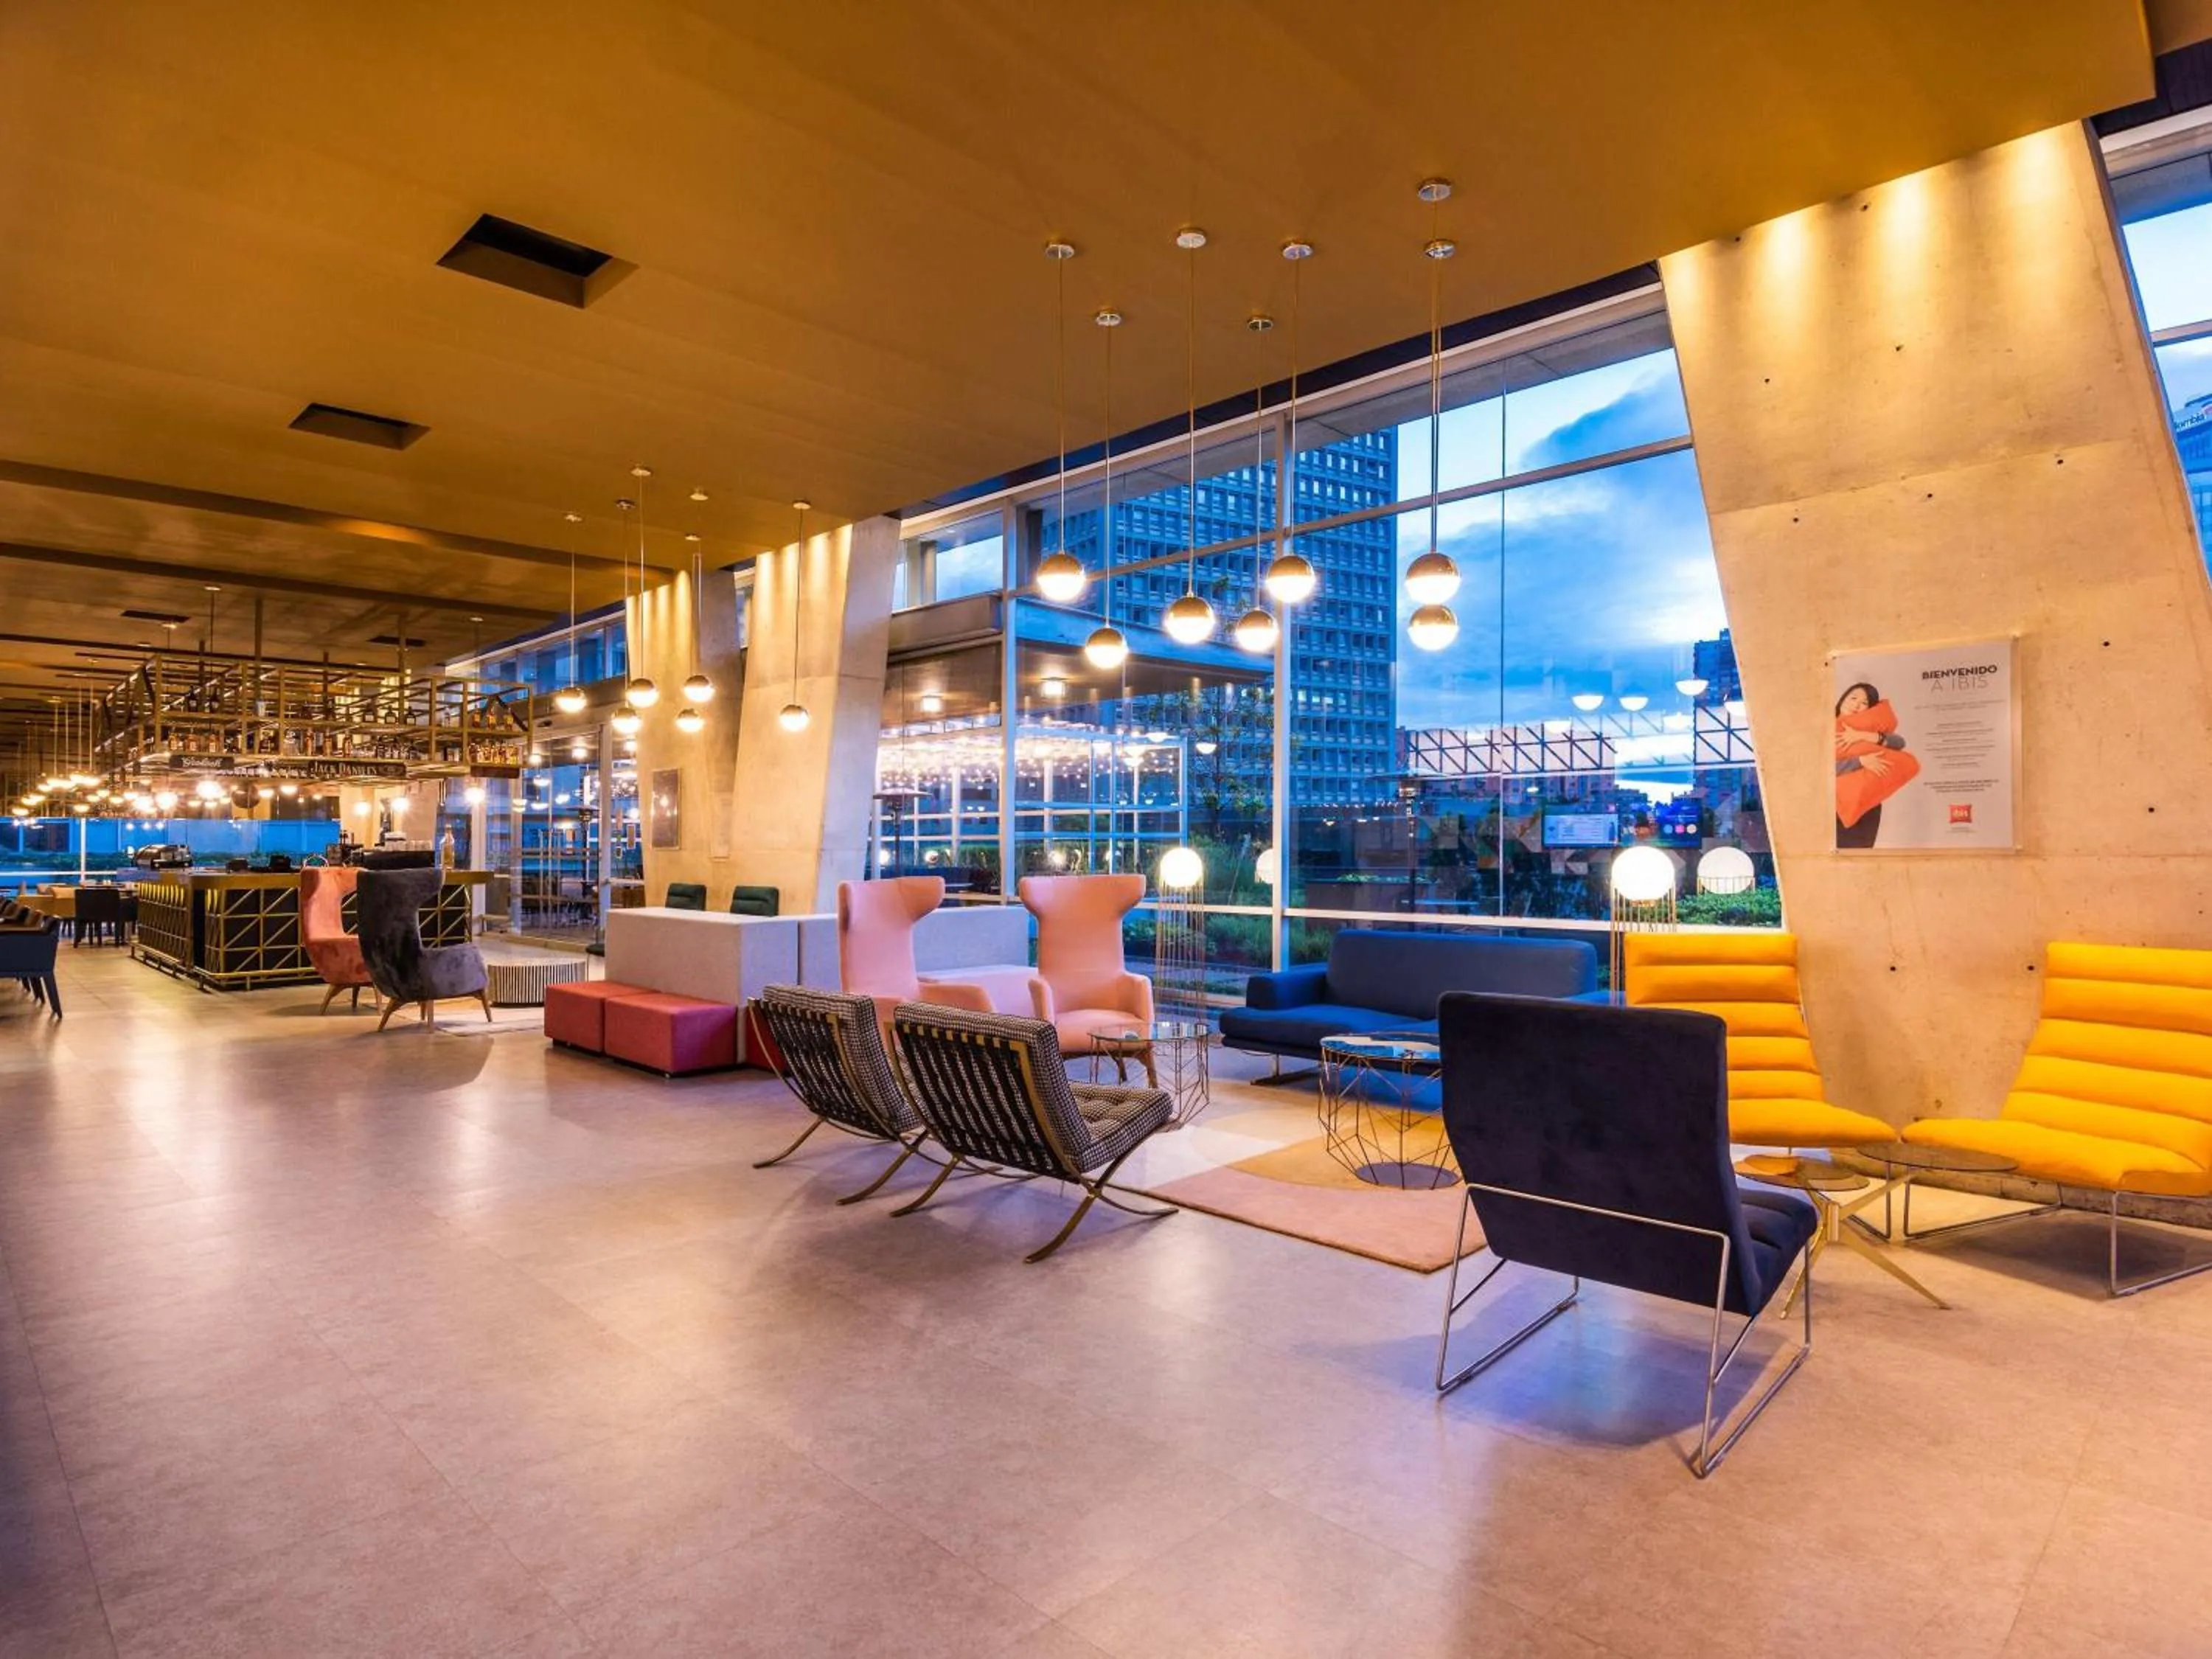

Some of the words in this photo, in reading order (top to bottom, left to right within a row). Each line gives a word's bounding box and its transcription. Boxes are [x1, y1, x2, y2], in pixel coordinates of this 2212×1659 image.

[1921, 664, 1997, 679] BIENVENIDO
[1930, 679, 1944, 692] A
[1952, 675, 1989, 692] IBIS
